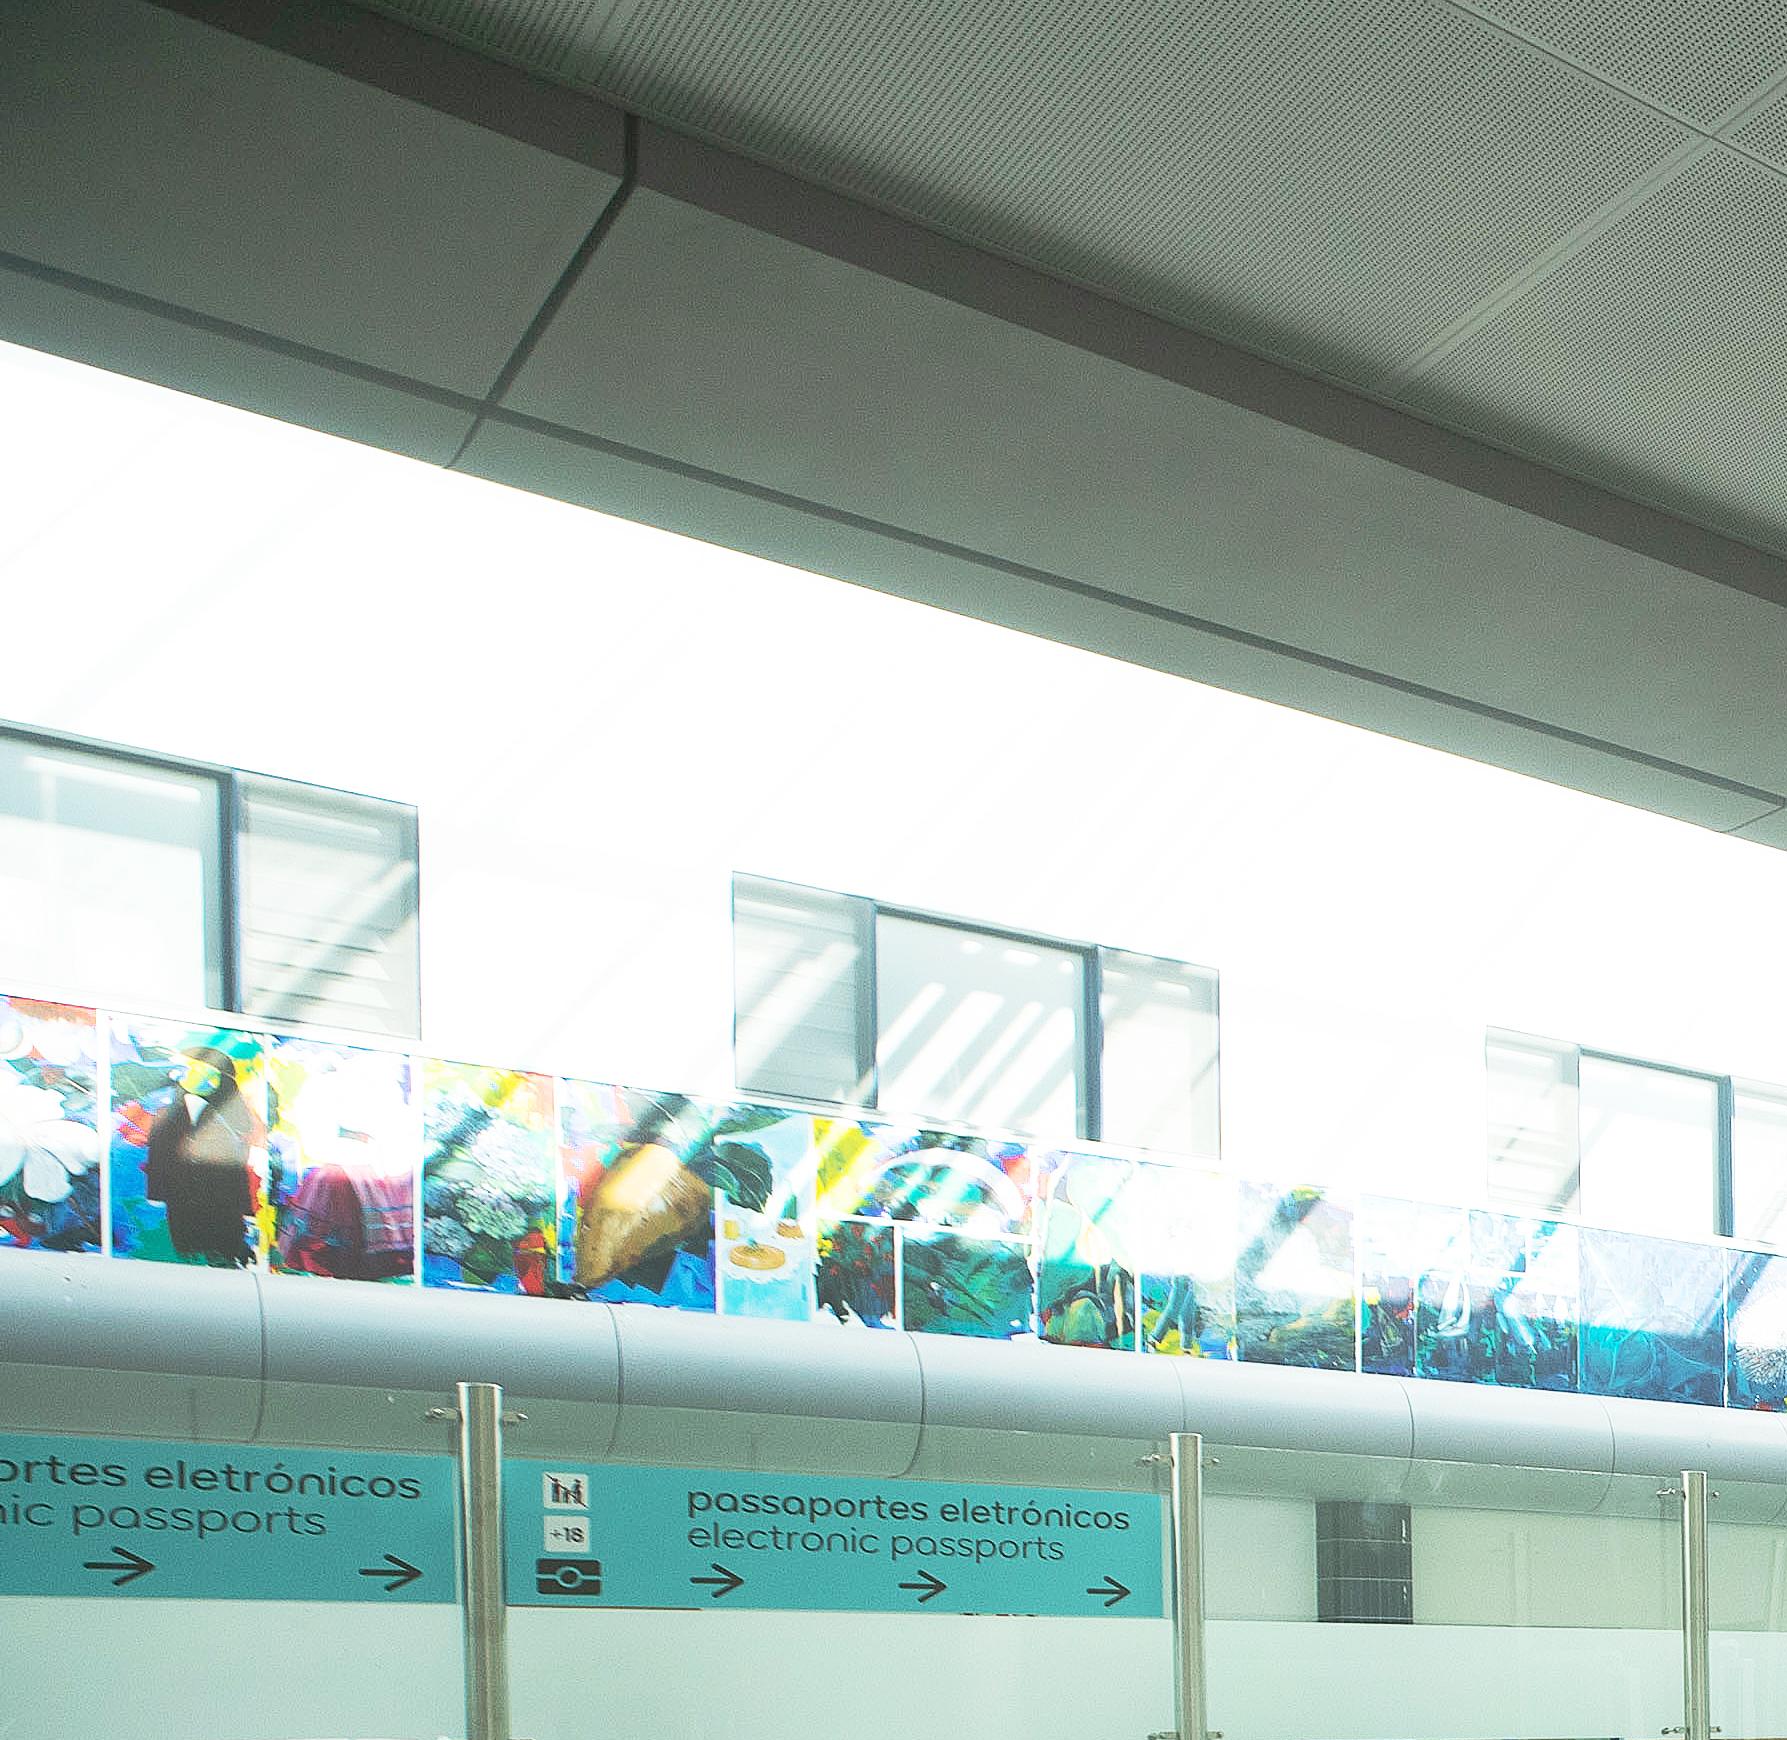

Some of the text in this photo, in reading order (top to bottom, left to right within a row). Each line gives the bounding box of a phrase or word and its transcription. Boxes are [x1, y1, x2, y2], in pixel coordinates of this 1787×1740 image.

[144, 1460, 421, 1500] eletrónicos
[73, 1501, 328, 1539] passports
[687, 1489, 1131, 1531] passaportes eletrónicos
[687, 1524, 1065, 1564] electronic passports
